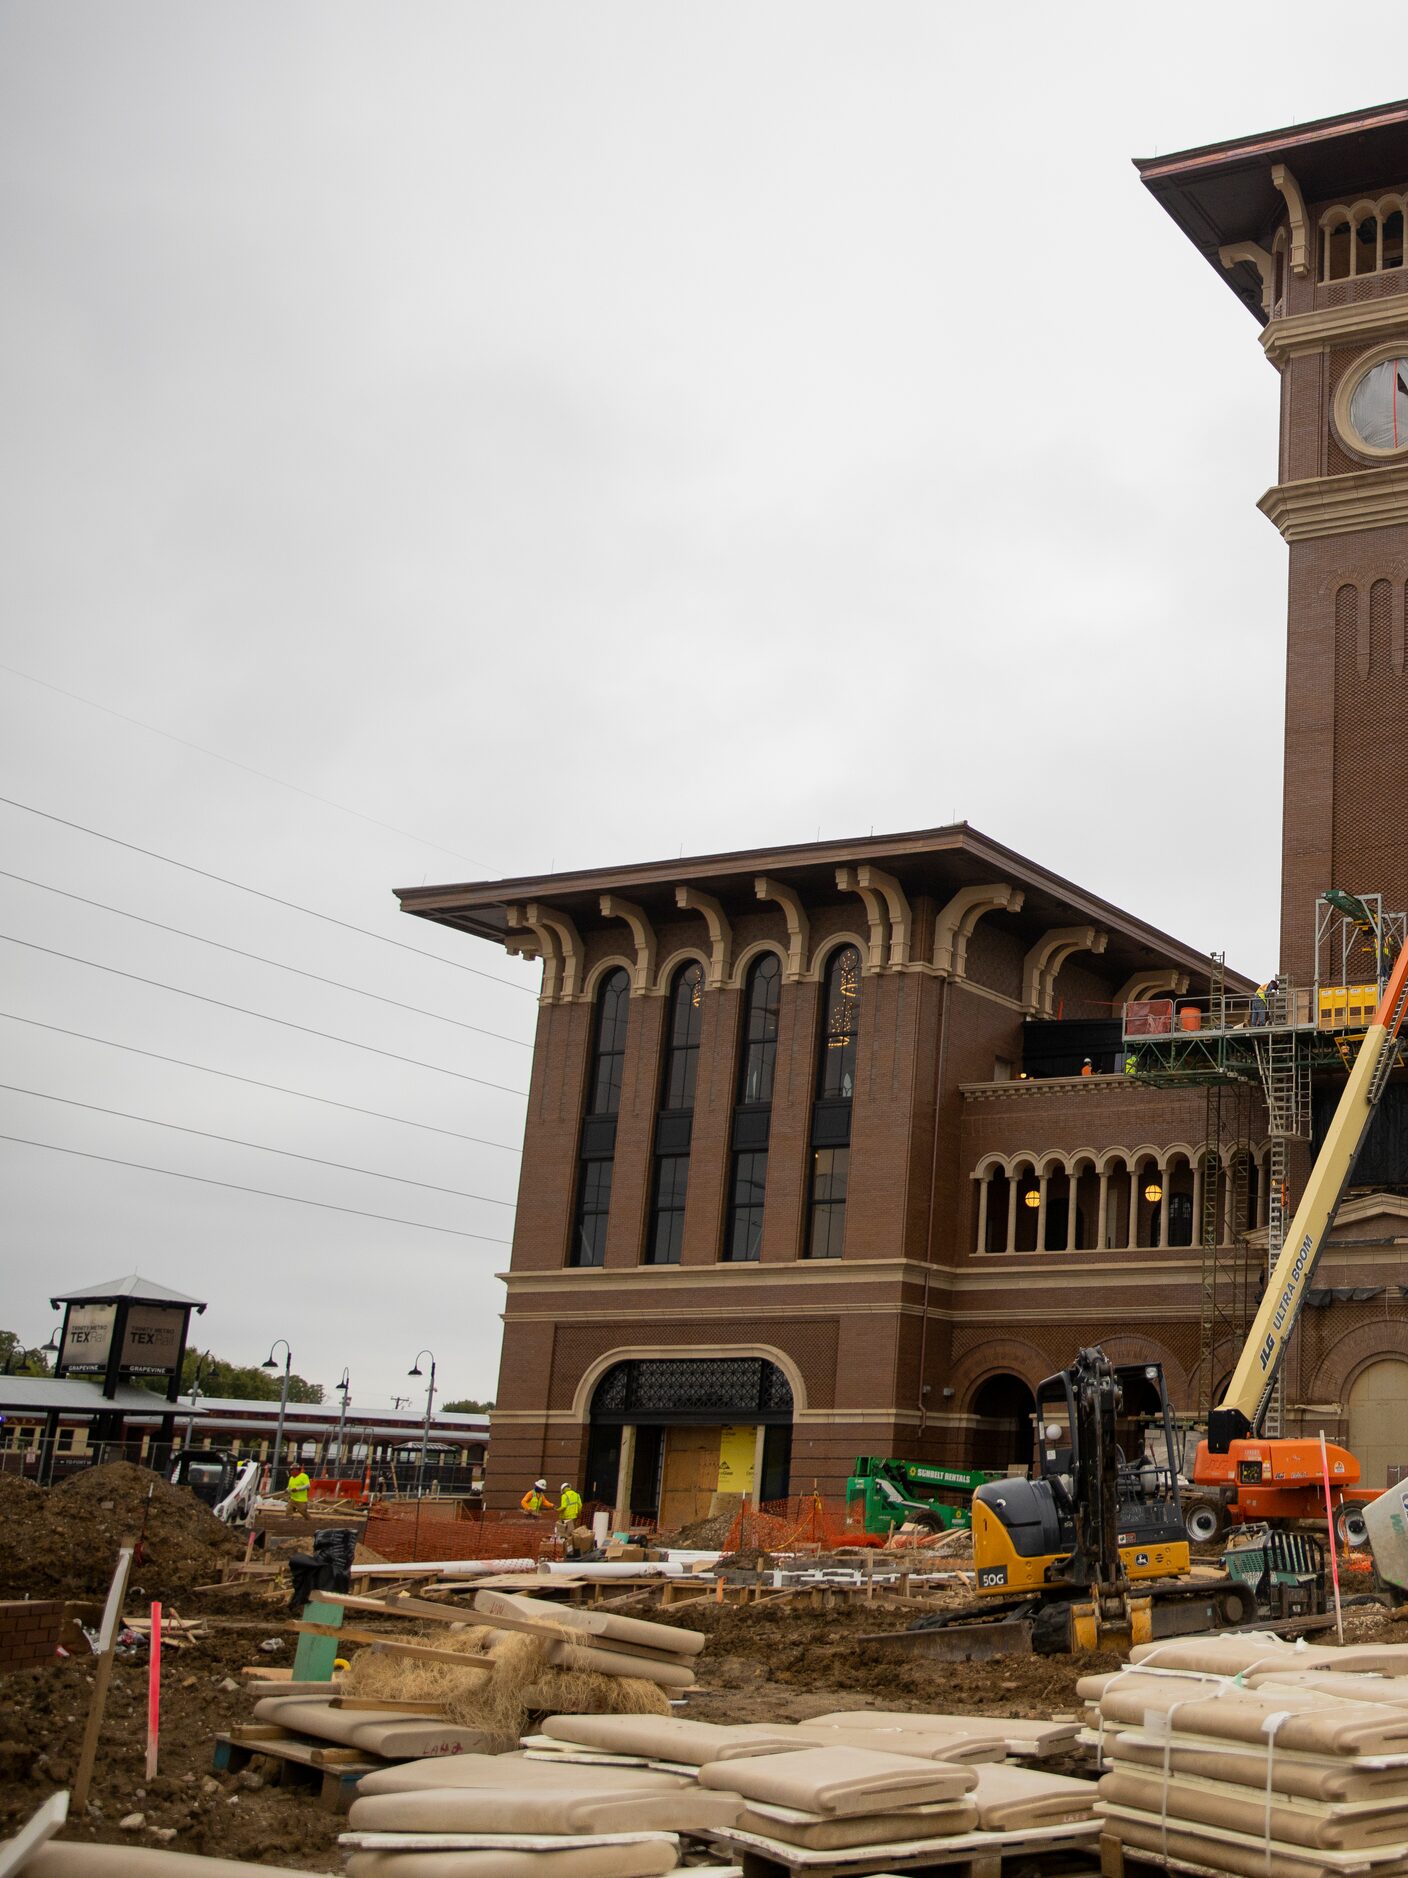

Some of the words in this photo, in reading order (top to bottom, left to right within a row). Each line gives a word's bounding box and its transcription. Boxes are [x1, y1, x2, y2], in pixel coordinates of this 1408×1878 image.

[1260, 1332, 1275, 1371] JLG
[1273, 1282, 1296, 1330] ULTRA
[1291, 1234, 1313, 1282] BOOM
[129, 1365, 166, 1374] GRAPEVINE
[917, 1468, 944, 1479] SUNBELT
[944, 1471, 971, 1483] RENTALS
[983, 1573, 1004, 1587] 50G
